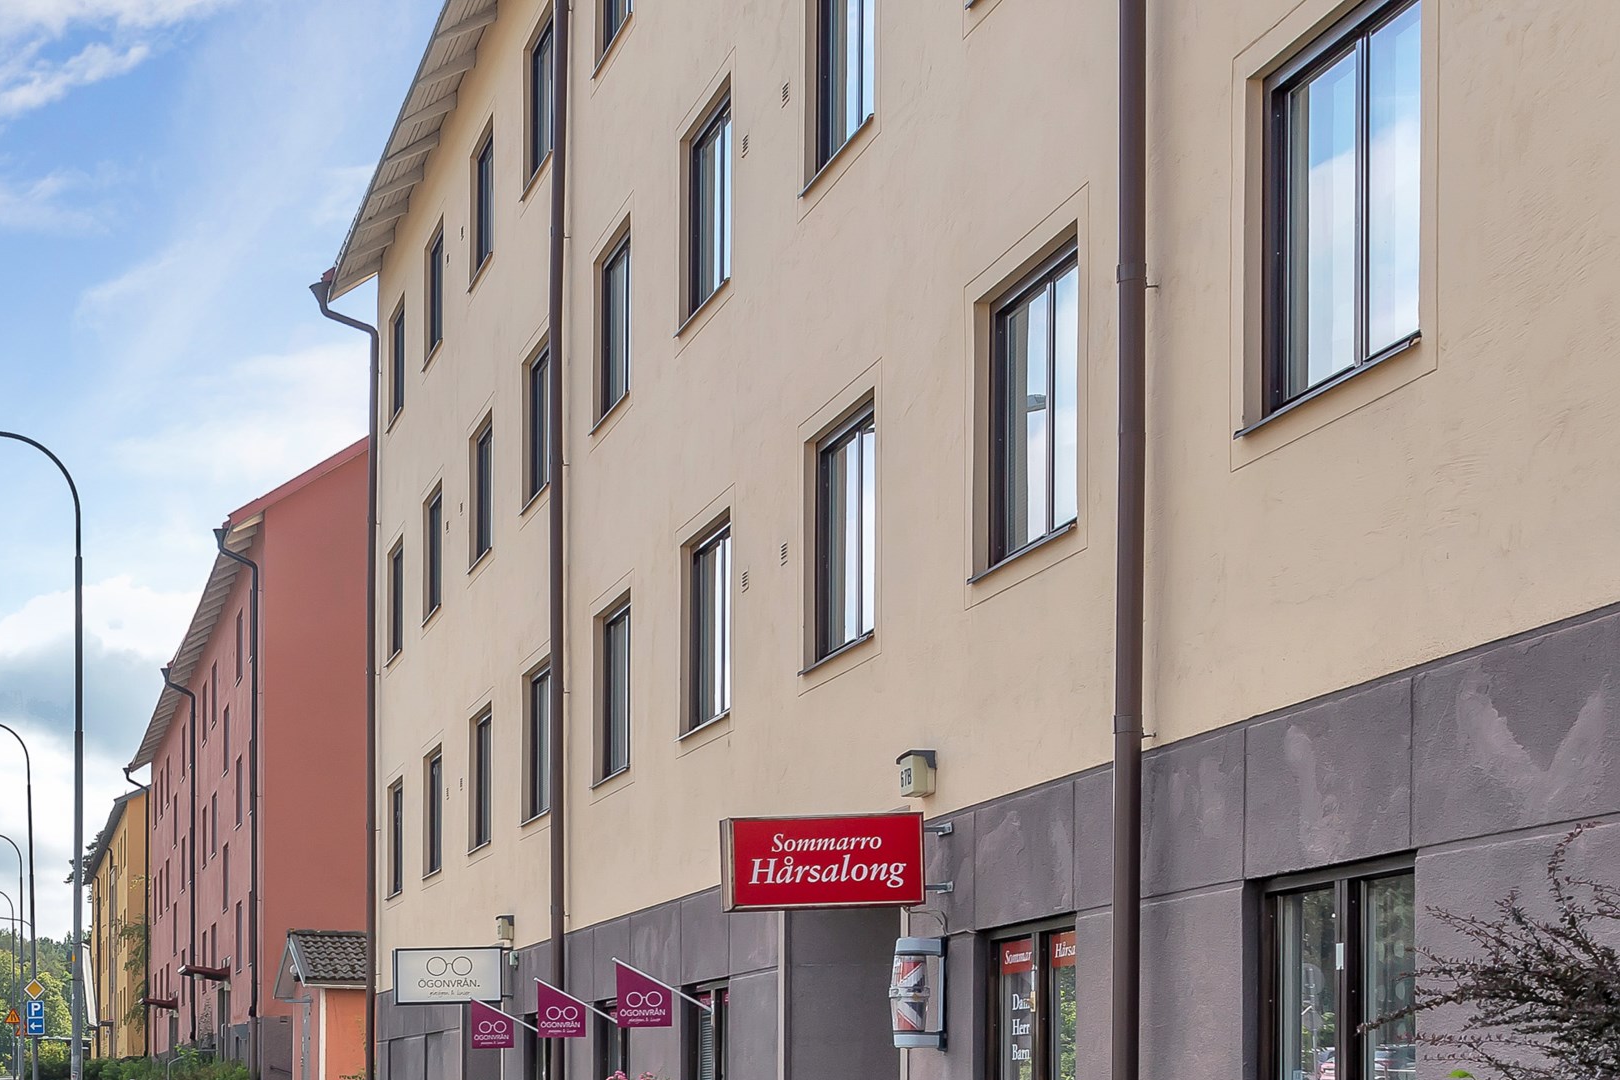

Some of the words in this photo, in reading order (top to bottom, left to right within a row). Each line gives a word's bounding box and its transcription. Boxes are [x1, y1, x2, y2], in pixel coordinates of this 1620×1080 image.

[771, 833, 883, 852] Sommarro
[748, 854, 907, 888] Hårsalong
[31, 1003, 41, 1016] P
[1012, 1019, 1030, 1036] Herr
[1012, 1043, 1030, 1060] Barn
